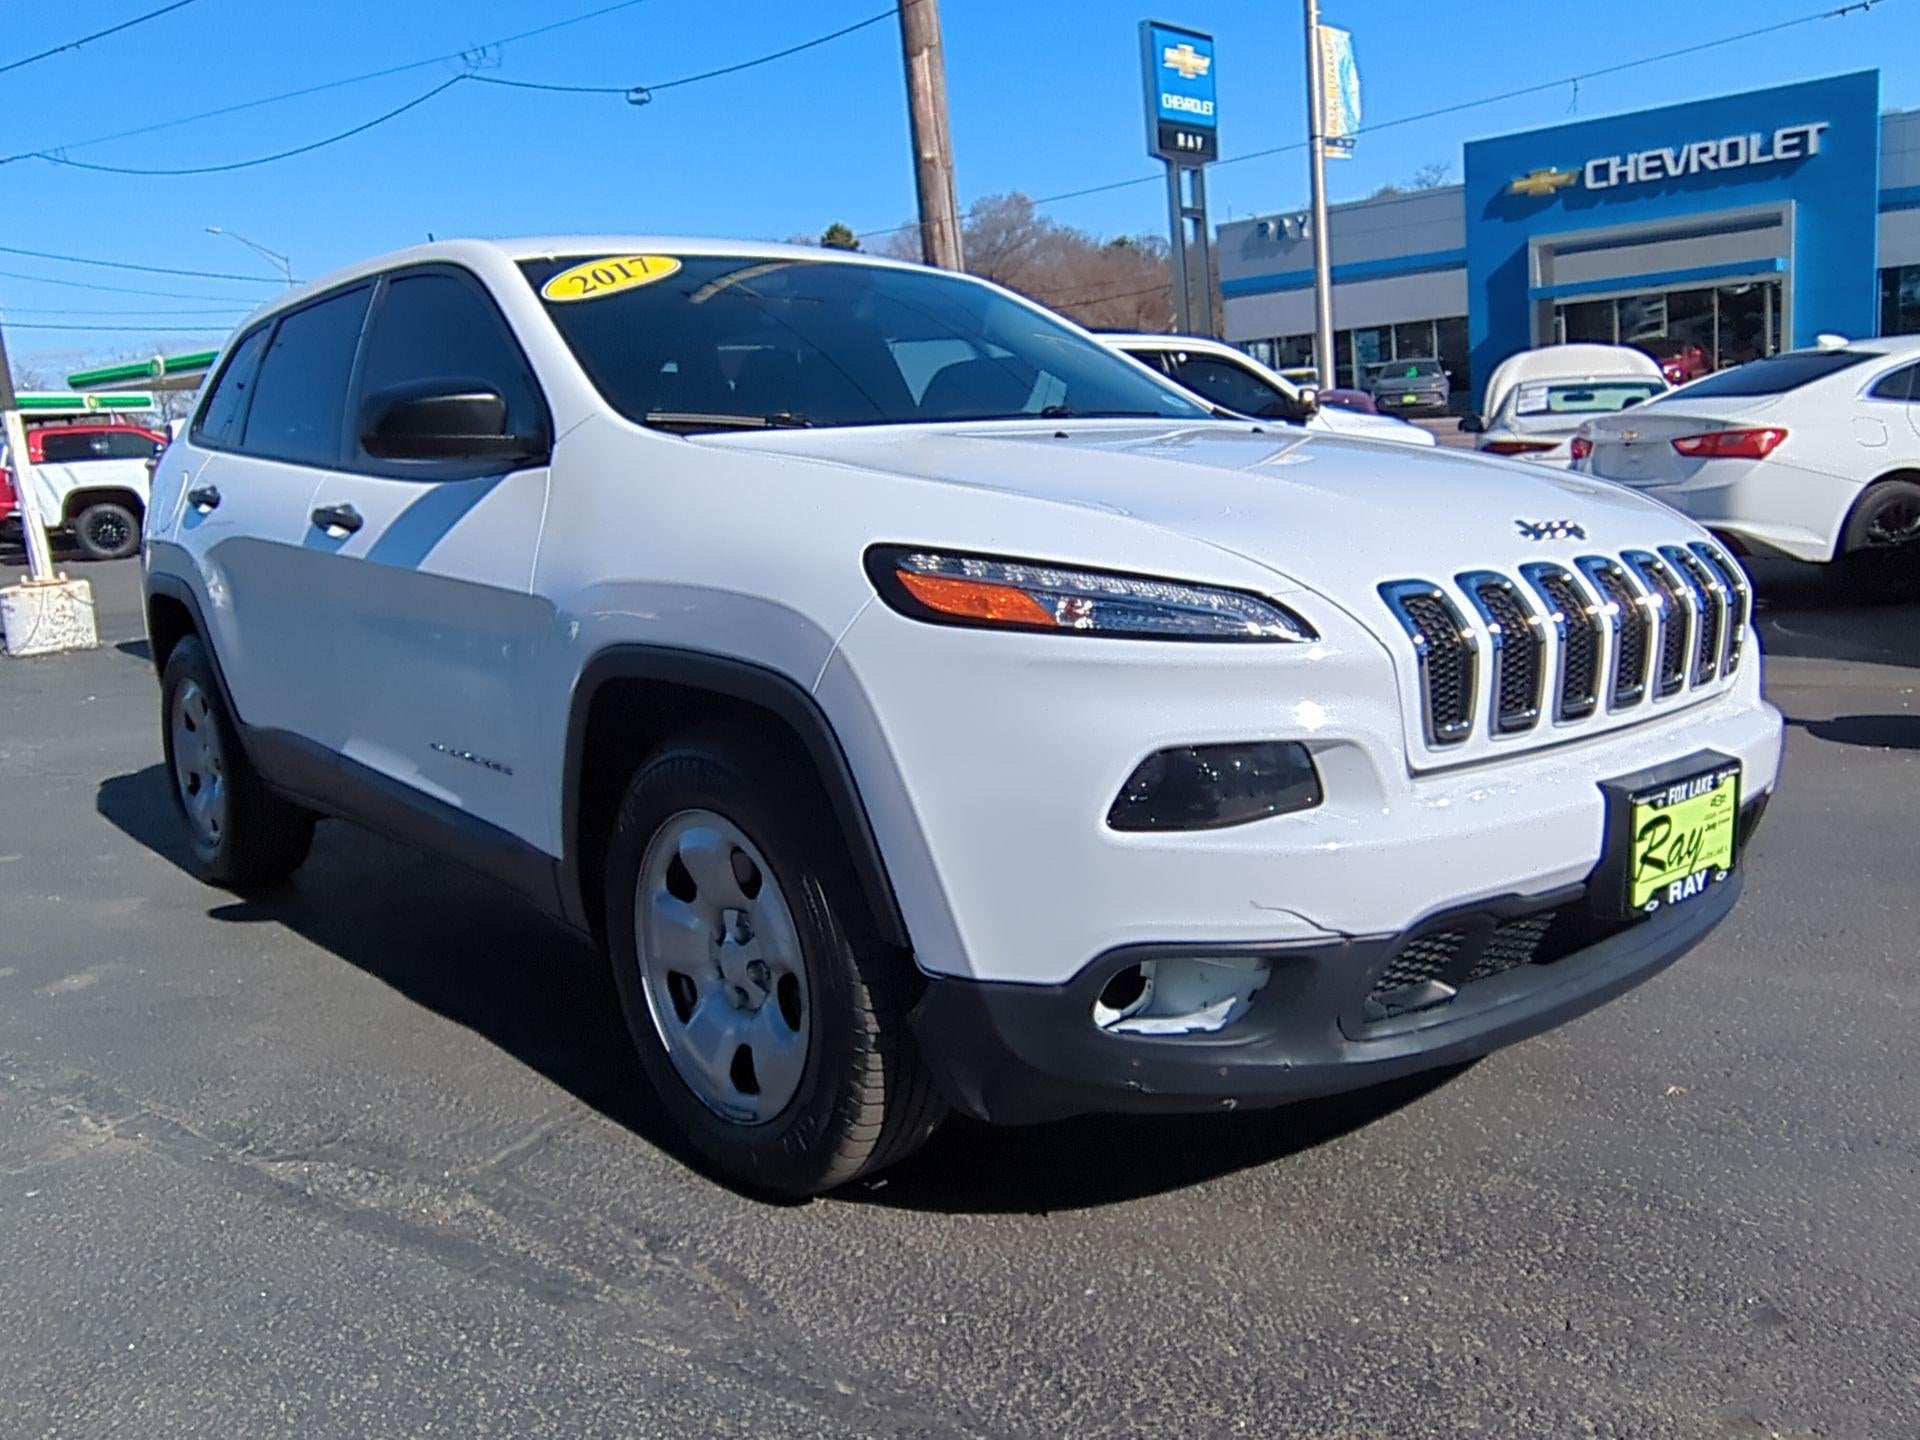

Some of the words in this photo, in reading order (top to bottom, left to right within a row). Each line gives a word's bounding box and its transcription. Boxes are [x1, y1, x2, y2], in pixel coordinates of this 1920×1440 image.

[1177, 132, 1203, 150] RAY
[1584, 121, 1830, 190] CHEVROLET
[1257, 215, 1309, 241] RAY
[568, 257, 649, 294] 2017
[1668, 781, 1689, 805] FOX
[1688, 774, 1714, 799] LAKE
[1636, 814, 1704, 882] Ray
[1668, 868, 1708, 904] RAY
